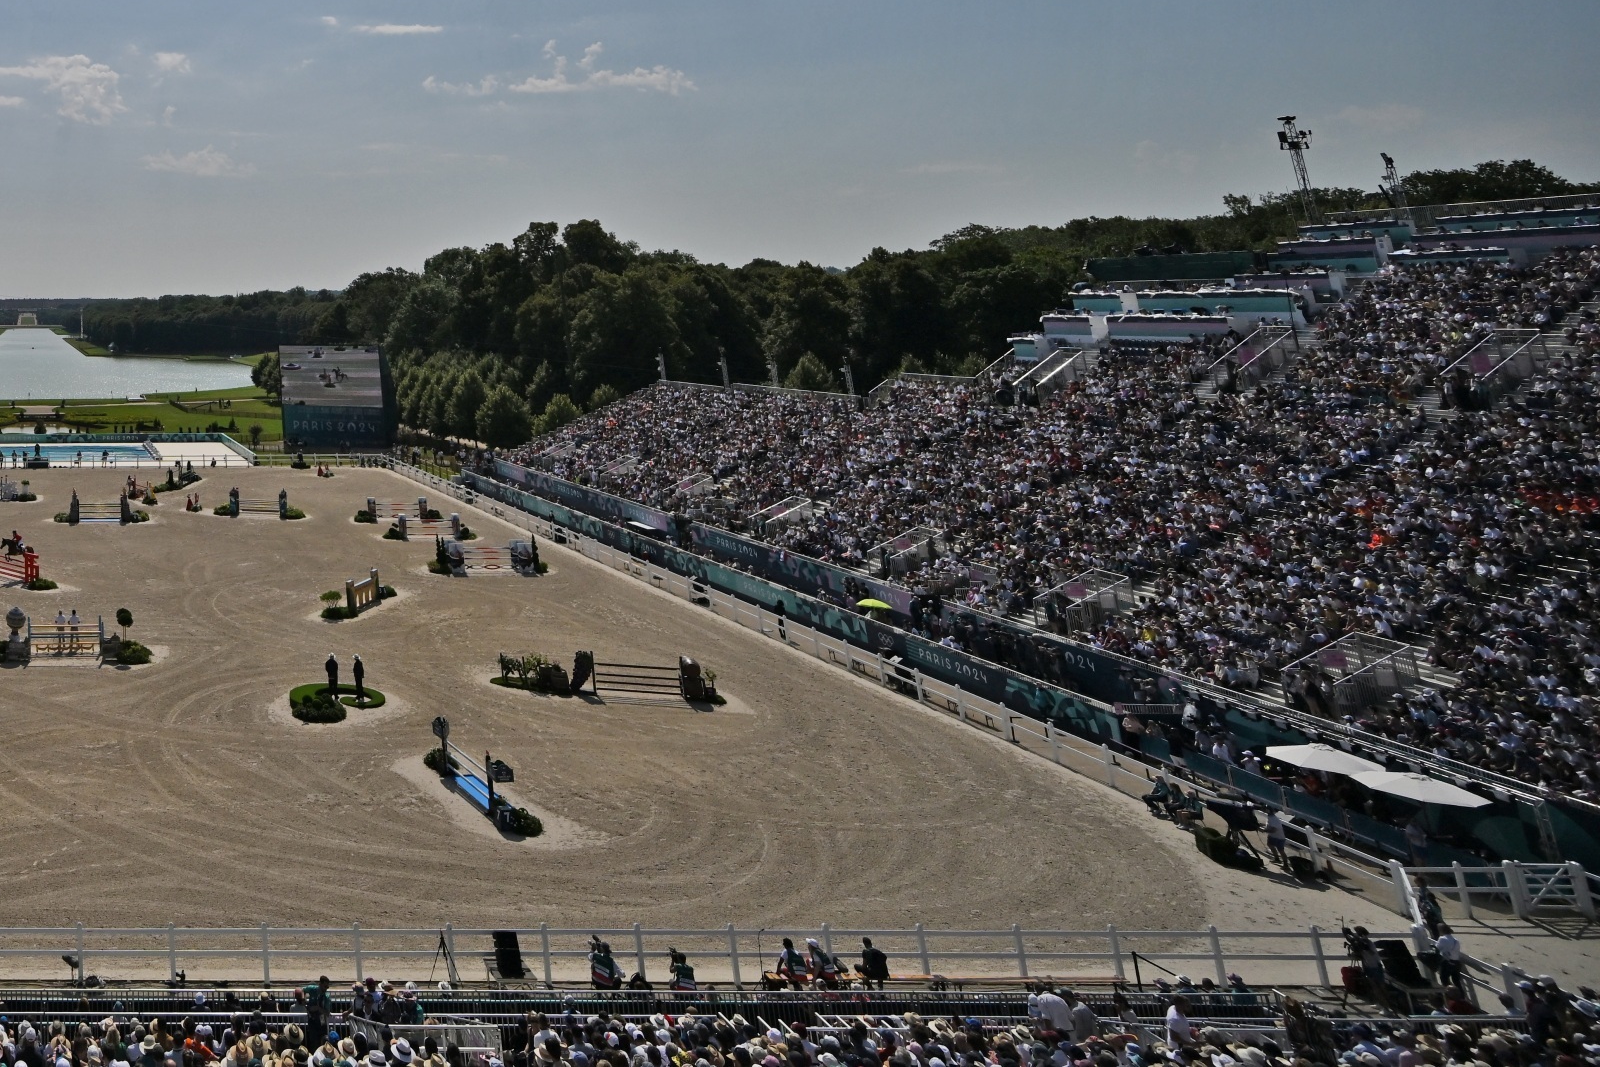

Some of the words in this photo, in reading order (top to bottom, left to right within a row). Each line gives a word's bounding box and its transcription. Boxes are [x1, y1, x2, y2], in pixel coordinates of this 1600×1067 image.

[738, 543, 758, 558] 2024
[955, 661, 988, 684] 2024
[1064, 651, 1096, 673] 024
